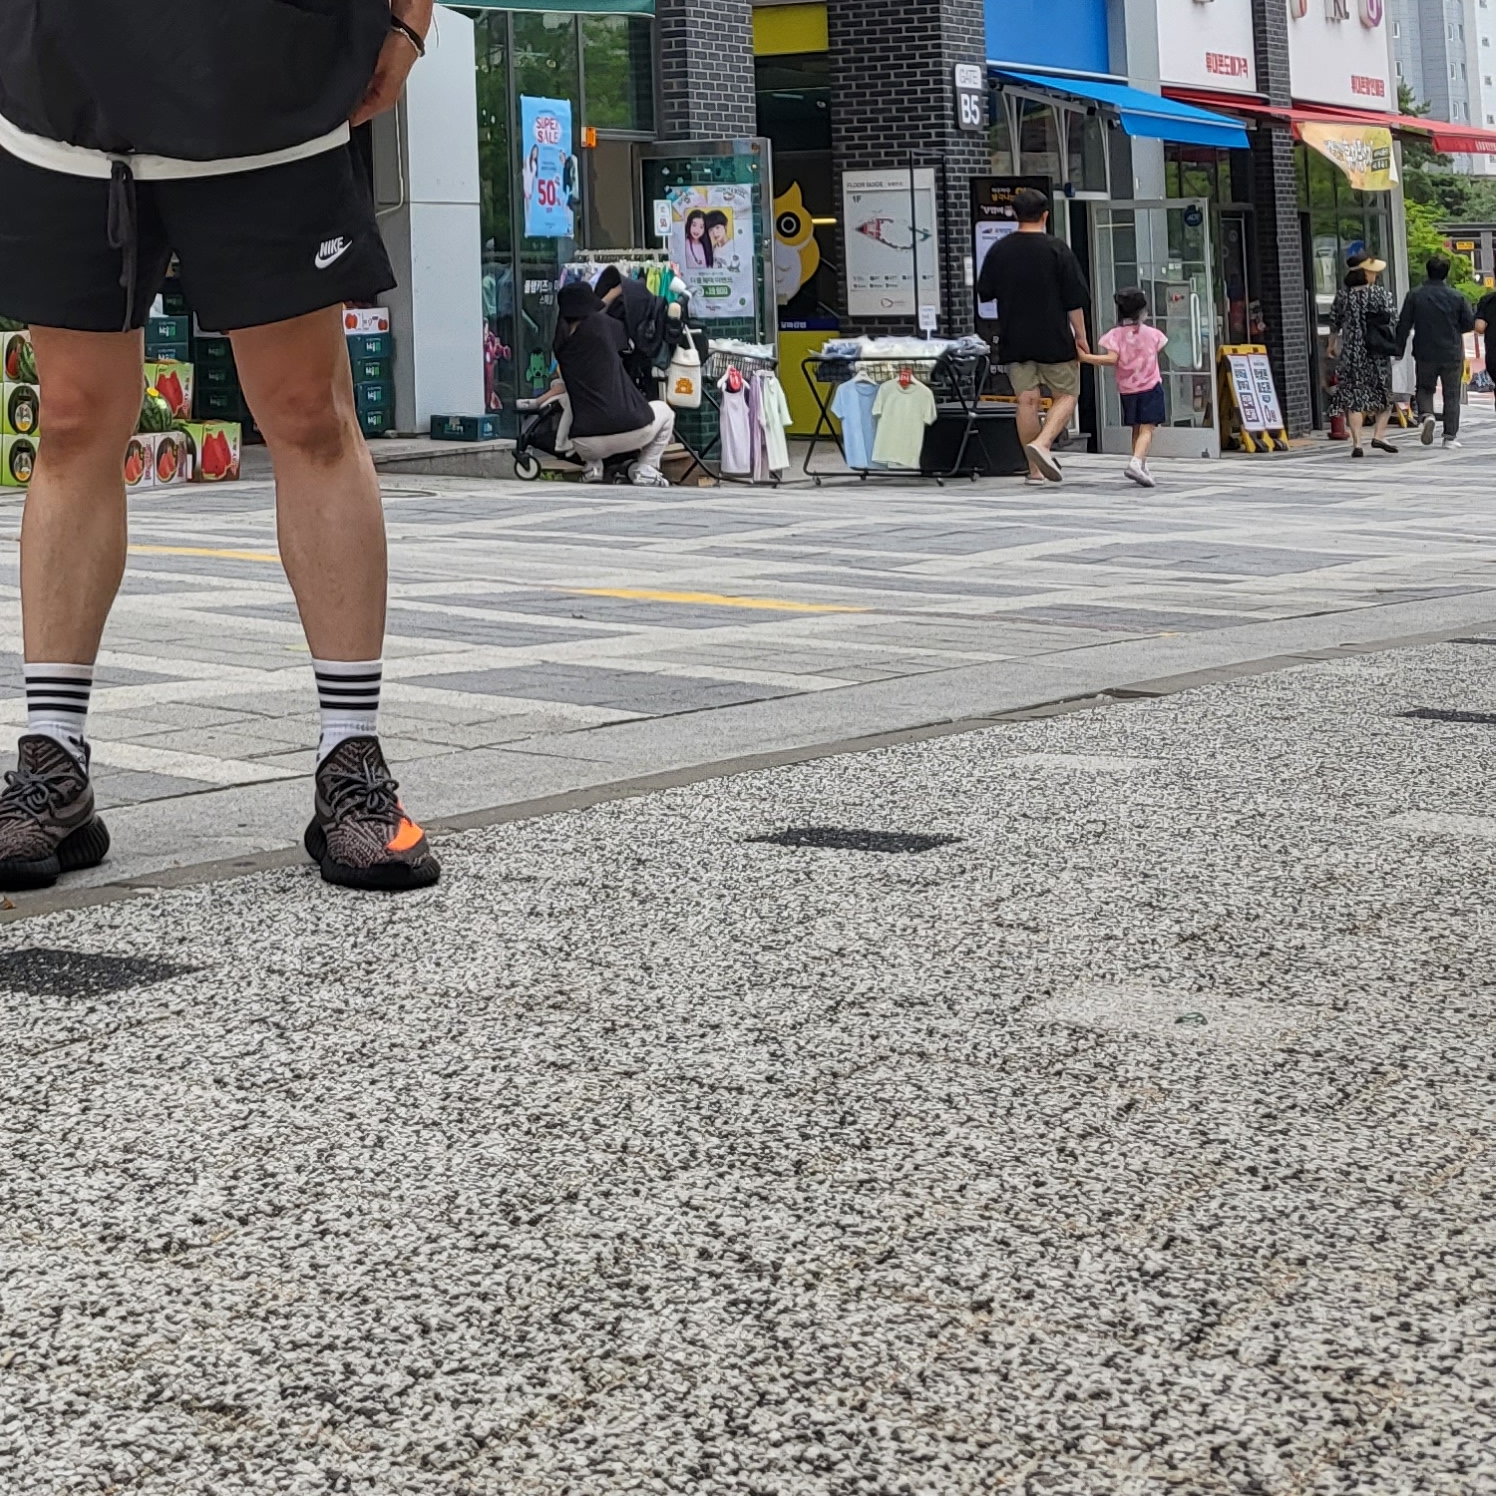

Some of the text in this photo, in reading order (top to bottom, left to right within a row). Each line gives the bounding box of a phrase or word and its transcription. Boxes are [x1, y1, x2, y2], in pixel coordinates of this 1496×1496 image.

[959, 68, 979, 86] GATE
[960, 92, 981, 125] B5
[319, 236, 344, 257] NIKE
